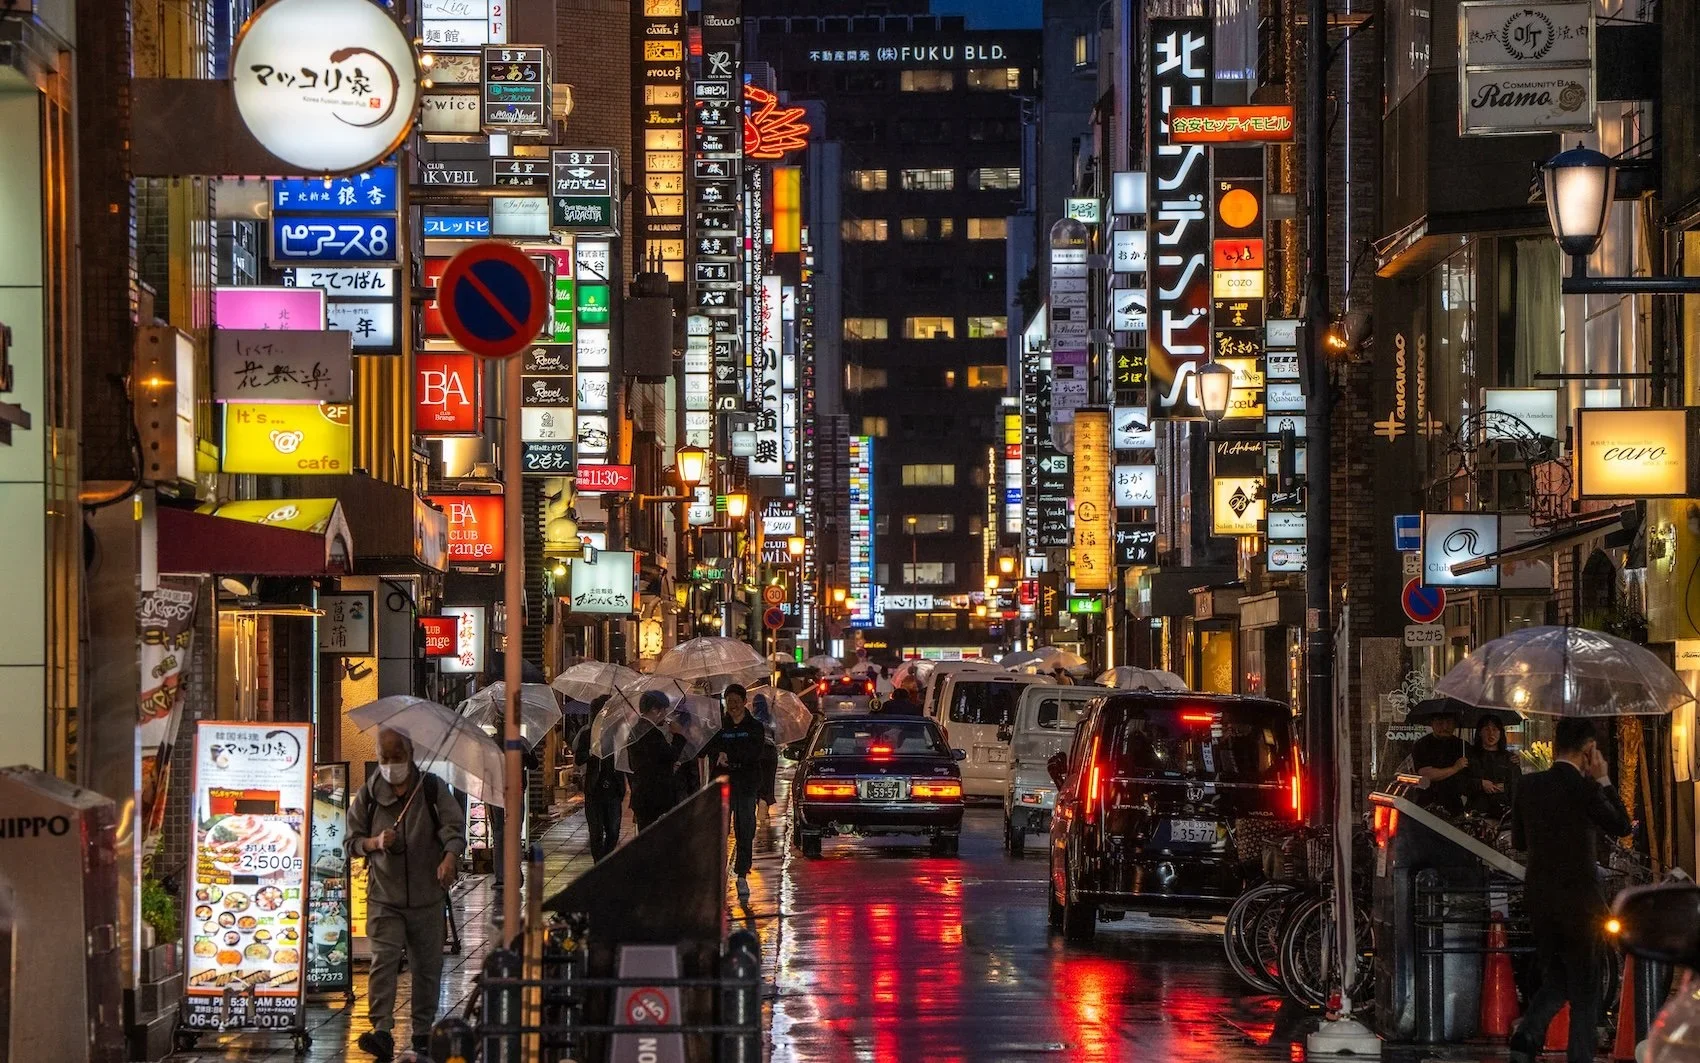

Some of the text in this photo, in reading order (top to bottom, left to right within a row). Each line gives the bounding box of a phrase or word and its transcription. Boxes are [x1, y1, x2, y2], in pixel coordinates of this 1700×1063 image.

[704, 19, 735, 27] REGALO
[647, 27, 672, 35] CAMEL
[809, 50, 870, 62] 不動産開発
[965, 45, 1007, 60] BLD.
[491, 64, 536, 81] こあら
[250, 64, 373, 96] マッコリ家
[1173, 117, 1291, 133] 谷安セッティモビル
[702, 142, 723, 150] Suite
[442, 172, 478, 183] VEIL
[338, 186, 386, 207] 銀杏
[503, 200, 540, 209] Infinity
[282, 224, 388, 257] ピアス8
[1118, 251, 1147, 260] おか
[1228, 279, 1252, 287] COZO
[535, 354, 561, 367] Revel
[536, 388, 562, 399] Revel
[327, 406, 348, 418] 2F
[1604, 446, 1666, 462] caro
[297, 455, 340, 470] cafe
[525, 454, 570, 471] ともえ
[1053, 460, 1066, 470] 96
[1117, 472, 1143, 485] おが
[1124, 489, 1153, 501] ちゃん
[449, 530, 478, 541] CLUB
[1116, 531, 1156, 544] ガーデニア
[448, 542, 493, 558] range
[764, 541, 788, 549] CLUB
[1126, 548, 1148, 560] ビル
[769, 589, 780, 600] 30
[459, 611, 476, 668] お好み焼
[1406, 630, 1443, 642] ここから
[225, 742, 287, 757] マッコリ家
[1181, 829, 1215, 840] 35-77
[243, 855, 302, 871] 2,500円
[275, 997, 298, 1006] 5:00
